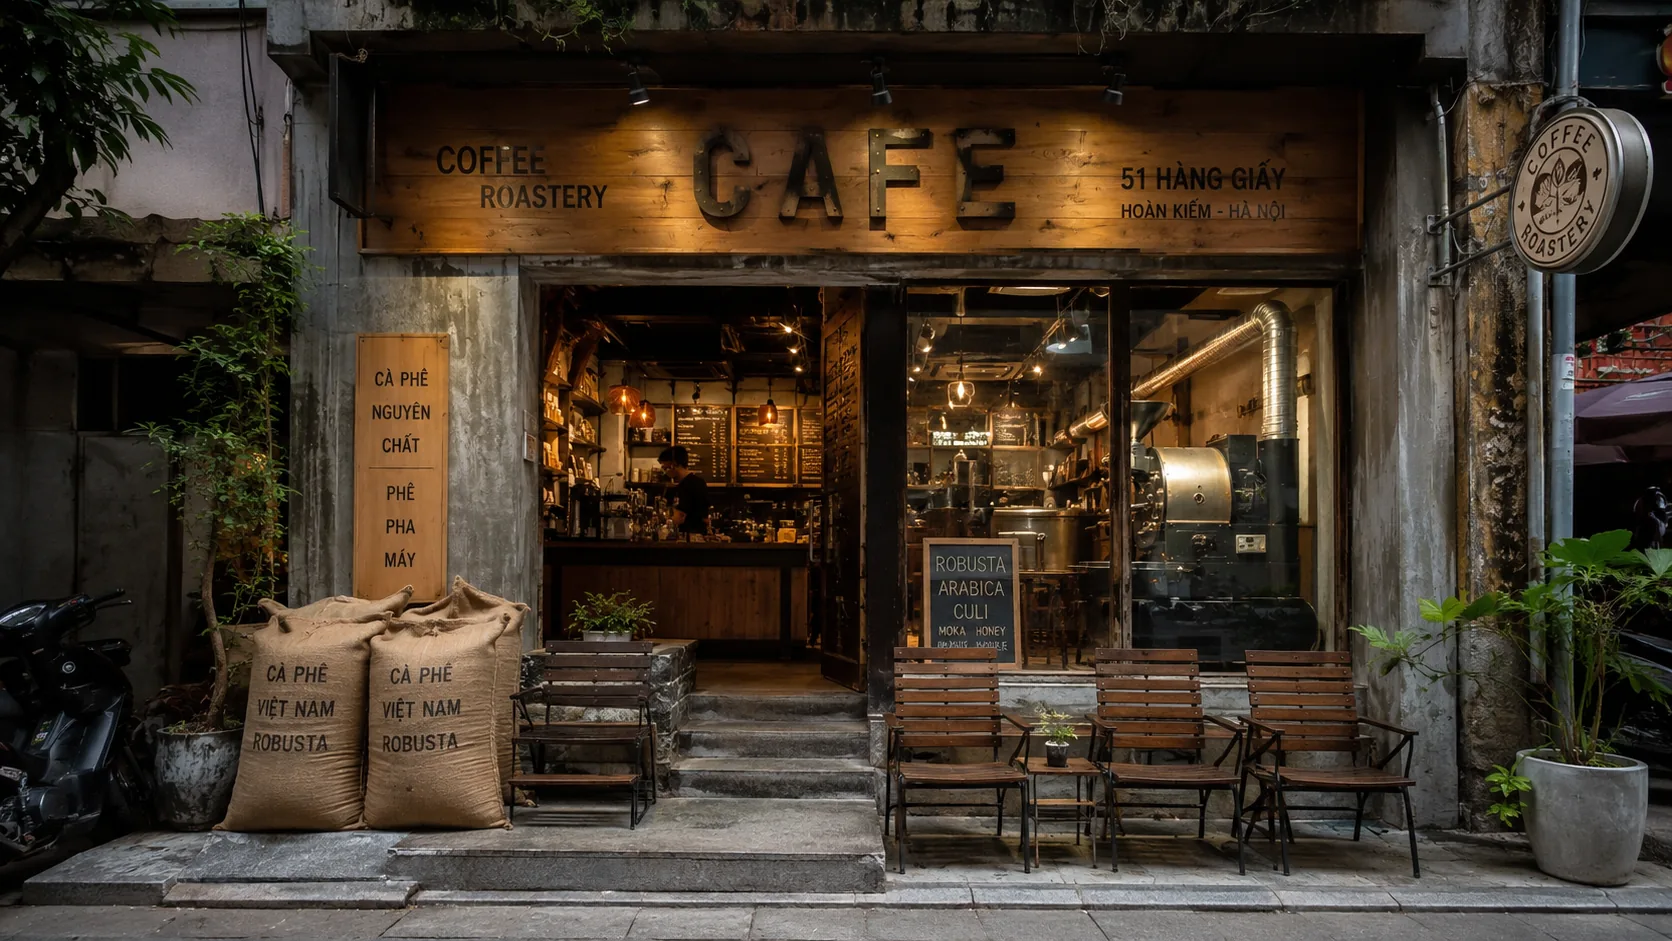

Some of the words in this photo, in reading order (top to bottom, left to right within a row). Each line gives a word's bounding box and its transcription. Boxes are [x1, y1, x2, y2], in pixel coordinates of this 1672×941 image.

[437, 145, 546, 175] COFFEE
[1527, 124, 1596, 176] COFFEE
[693, 127, 1016, 222] CAFE
[1121, 167, 1145, 190] 51
[1156, 161, 1223, 190] HÀNG
[1231, 159, 1287, 190] GIẤY
[480, 184, 608, 209] ROASTERY
[1121, 199, 1167, 219] HOÀN
[1173, 198, 1211, 219] KIẾM
[1229, 199, 1252, 219] HÀ
[1257, 200, 1286, 222] NỘI
[1521, 199, 1595, 258] ROASTERY
[375, 368, 394, 387] CÀ
[400, 368, 429, 387] PHÊ
[372, 402, 431, 420] NGUYÊN
[382, 433, 420, 454] CHẤT
[386, 482, 415, 501] PHÊ
[386, 519, 416, 534] PHA
[384, 549, 416, 567] MÁY
[935, 556, 1007, 573] ROBUSTA
[938, 580, 1005, 597] ARABICA
[953, 603, 988, 620] CULI
[938, 626, 966, 637] MOKA
[976, 625, 1007, 637] HONEY
[267, 662, 287, 683] CÀ
[293, 663, 329, 683] PHÊ
[390, 664, 412, 685] CÀ
[419, 662, 453, 684] PHÊ
[258, 696, 288, 720] VIỆT
[294, 700, 336, 717] NAM
[383, 698, 416, 722] VIỆT
[422, 698, 461, 718] NAM
[252, 732, 328, 752] ROBUSTA
[382, 733, 459, 753] ROBUSTA
